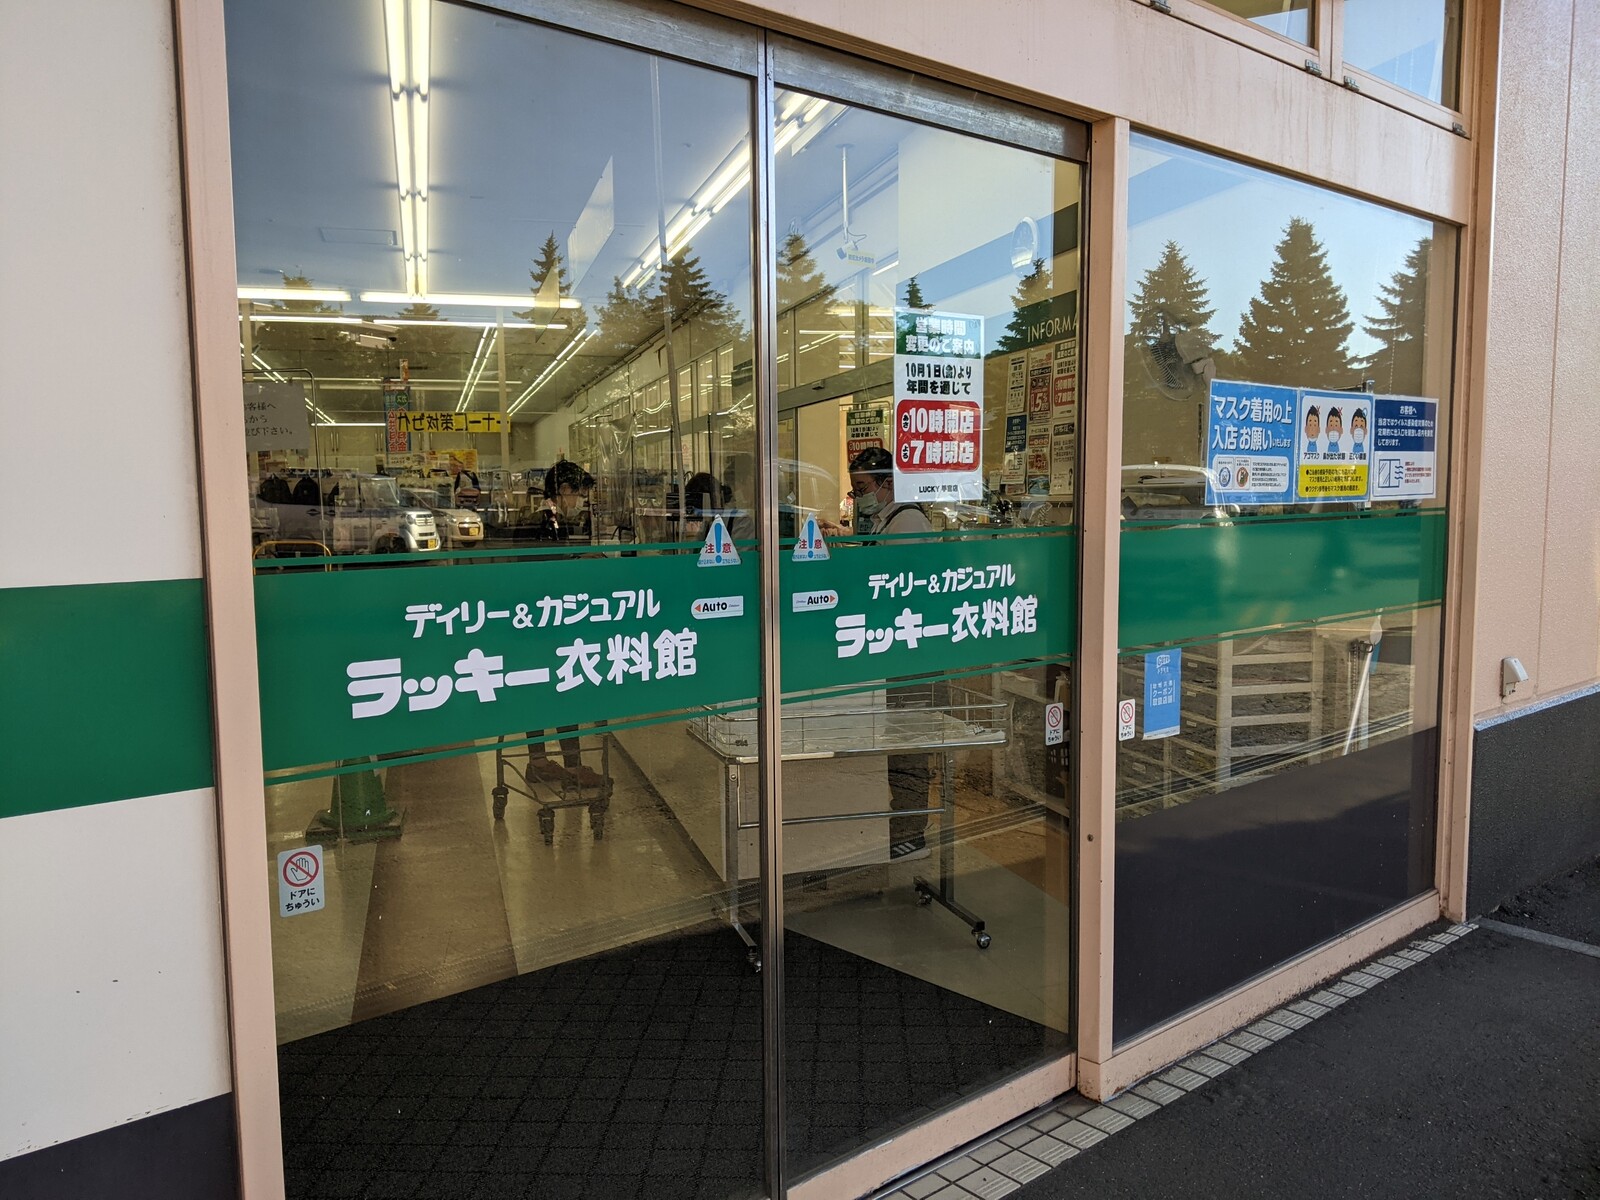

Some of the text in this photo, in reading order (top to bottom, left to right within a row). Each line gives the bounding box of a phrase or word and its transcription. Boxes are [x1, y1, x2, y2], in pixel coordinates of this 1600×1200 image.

[906, 379, 972, 395] 年間を通じて
[1214, 397, 1292, 424] マスク着用の上
[919, 485, 940, 493] LUCKY
[702, 601, 728, 612] Auto
[807, 595, 829, 605] Auto
[835, 594, 1038, 658] ラッキー衣料館
[346, 627, 698, 719] ラッキー衣料館
[290, 888, 316, 900] ドアに
[285, 898, 320, 912] ちゅうい
